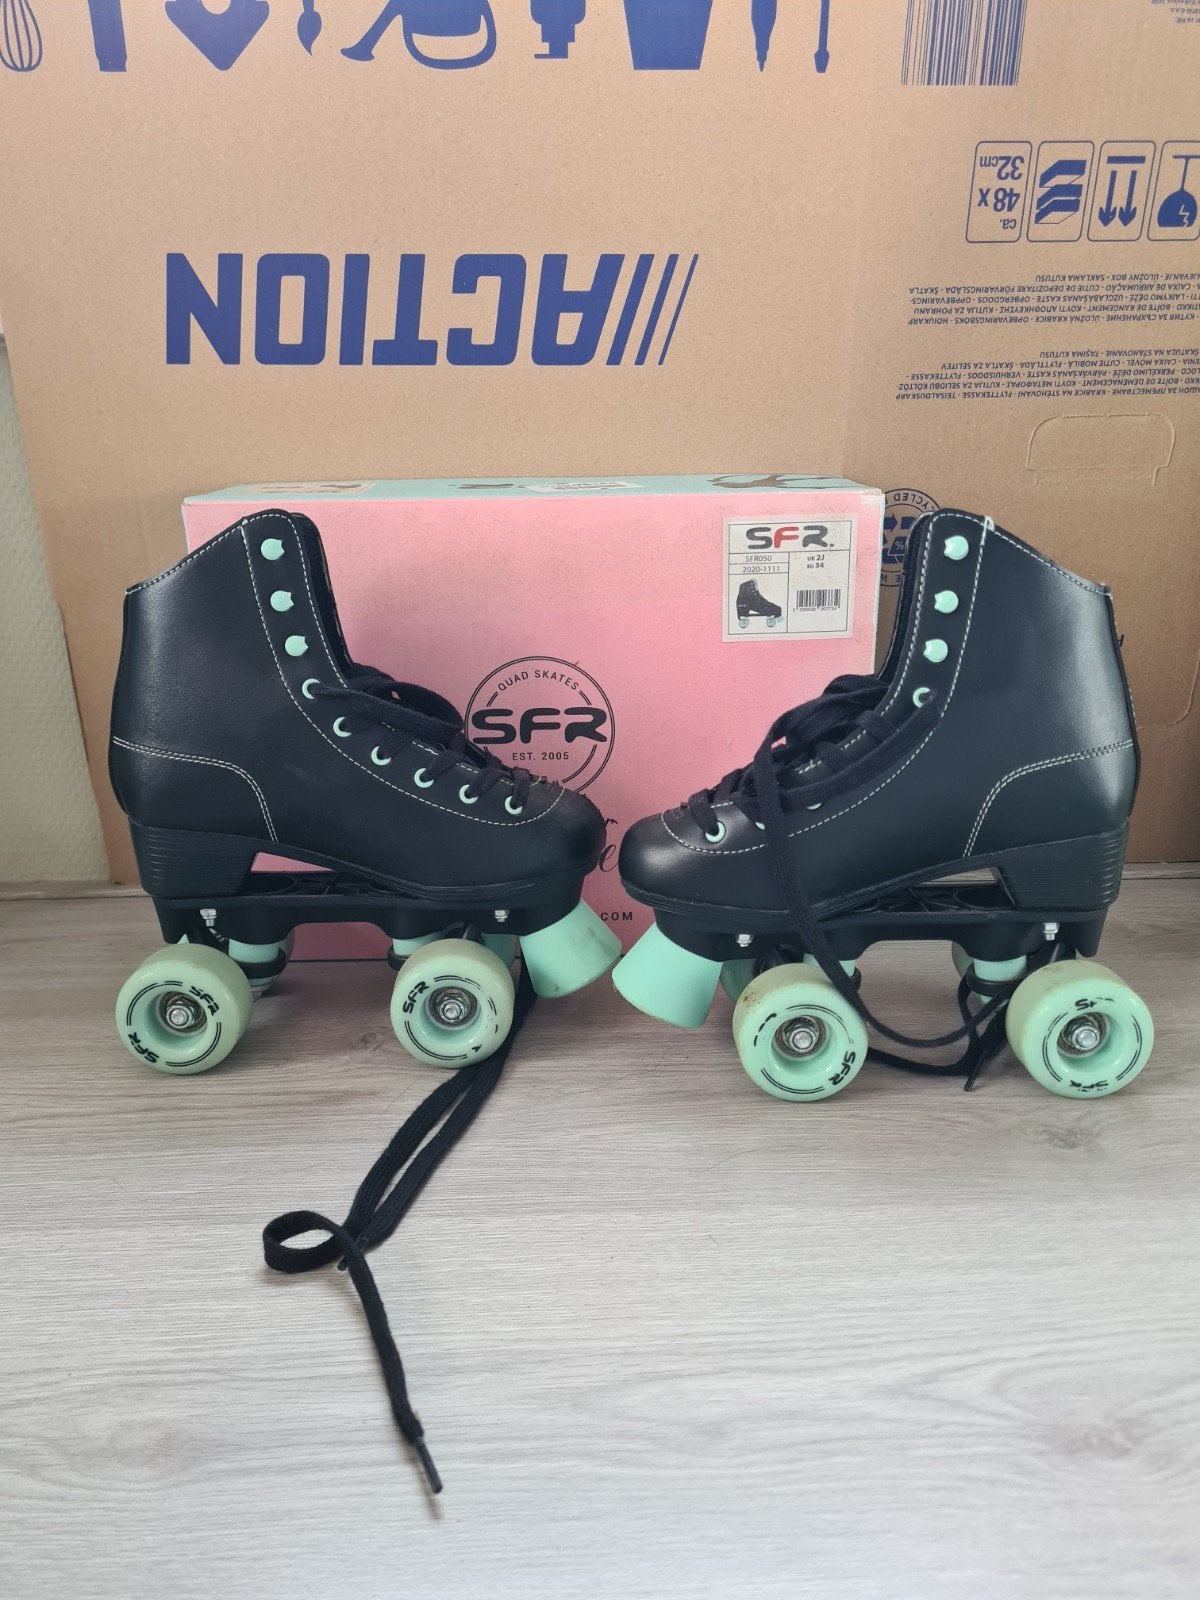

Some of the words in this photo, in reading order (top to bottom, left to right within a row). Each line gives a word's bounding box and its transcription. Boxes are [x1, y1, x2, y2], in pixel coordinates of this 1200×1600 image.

[979, 155, 1024, 180] 32cm
[993, 187, 1020, 212] 48
[1000, 218, 1016, 229] ca.
[1017, 285, 1063, 293] DEPOZITARE
[166, 253, 624, 365] ACTION
[955, 316, 1028, 324] OPBEVARINGSBOKS
[893, 492, 935, 510] YCLED
[497, 671, 529, 691] QUAD
[534, 669, 579, 690] SKATES
[471, 707, 607, 745] SFR
[512, 752, 536, 761] EST.
[541, 752, 569, 760] 2005
[189, 986, 219, 1016] SFR
[402, 981, 430, 1014] SFR
[128, 1032, 159, 1063] SFR
[828, 1051, 856, 1085] SFR
